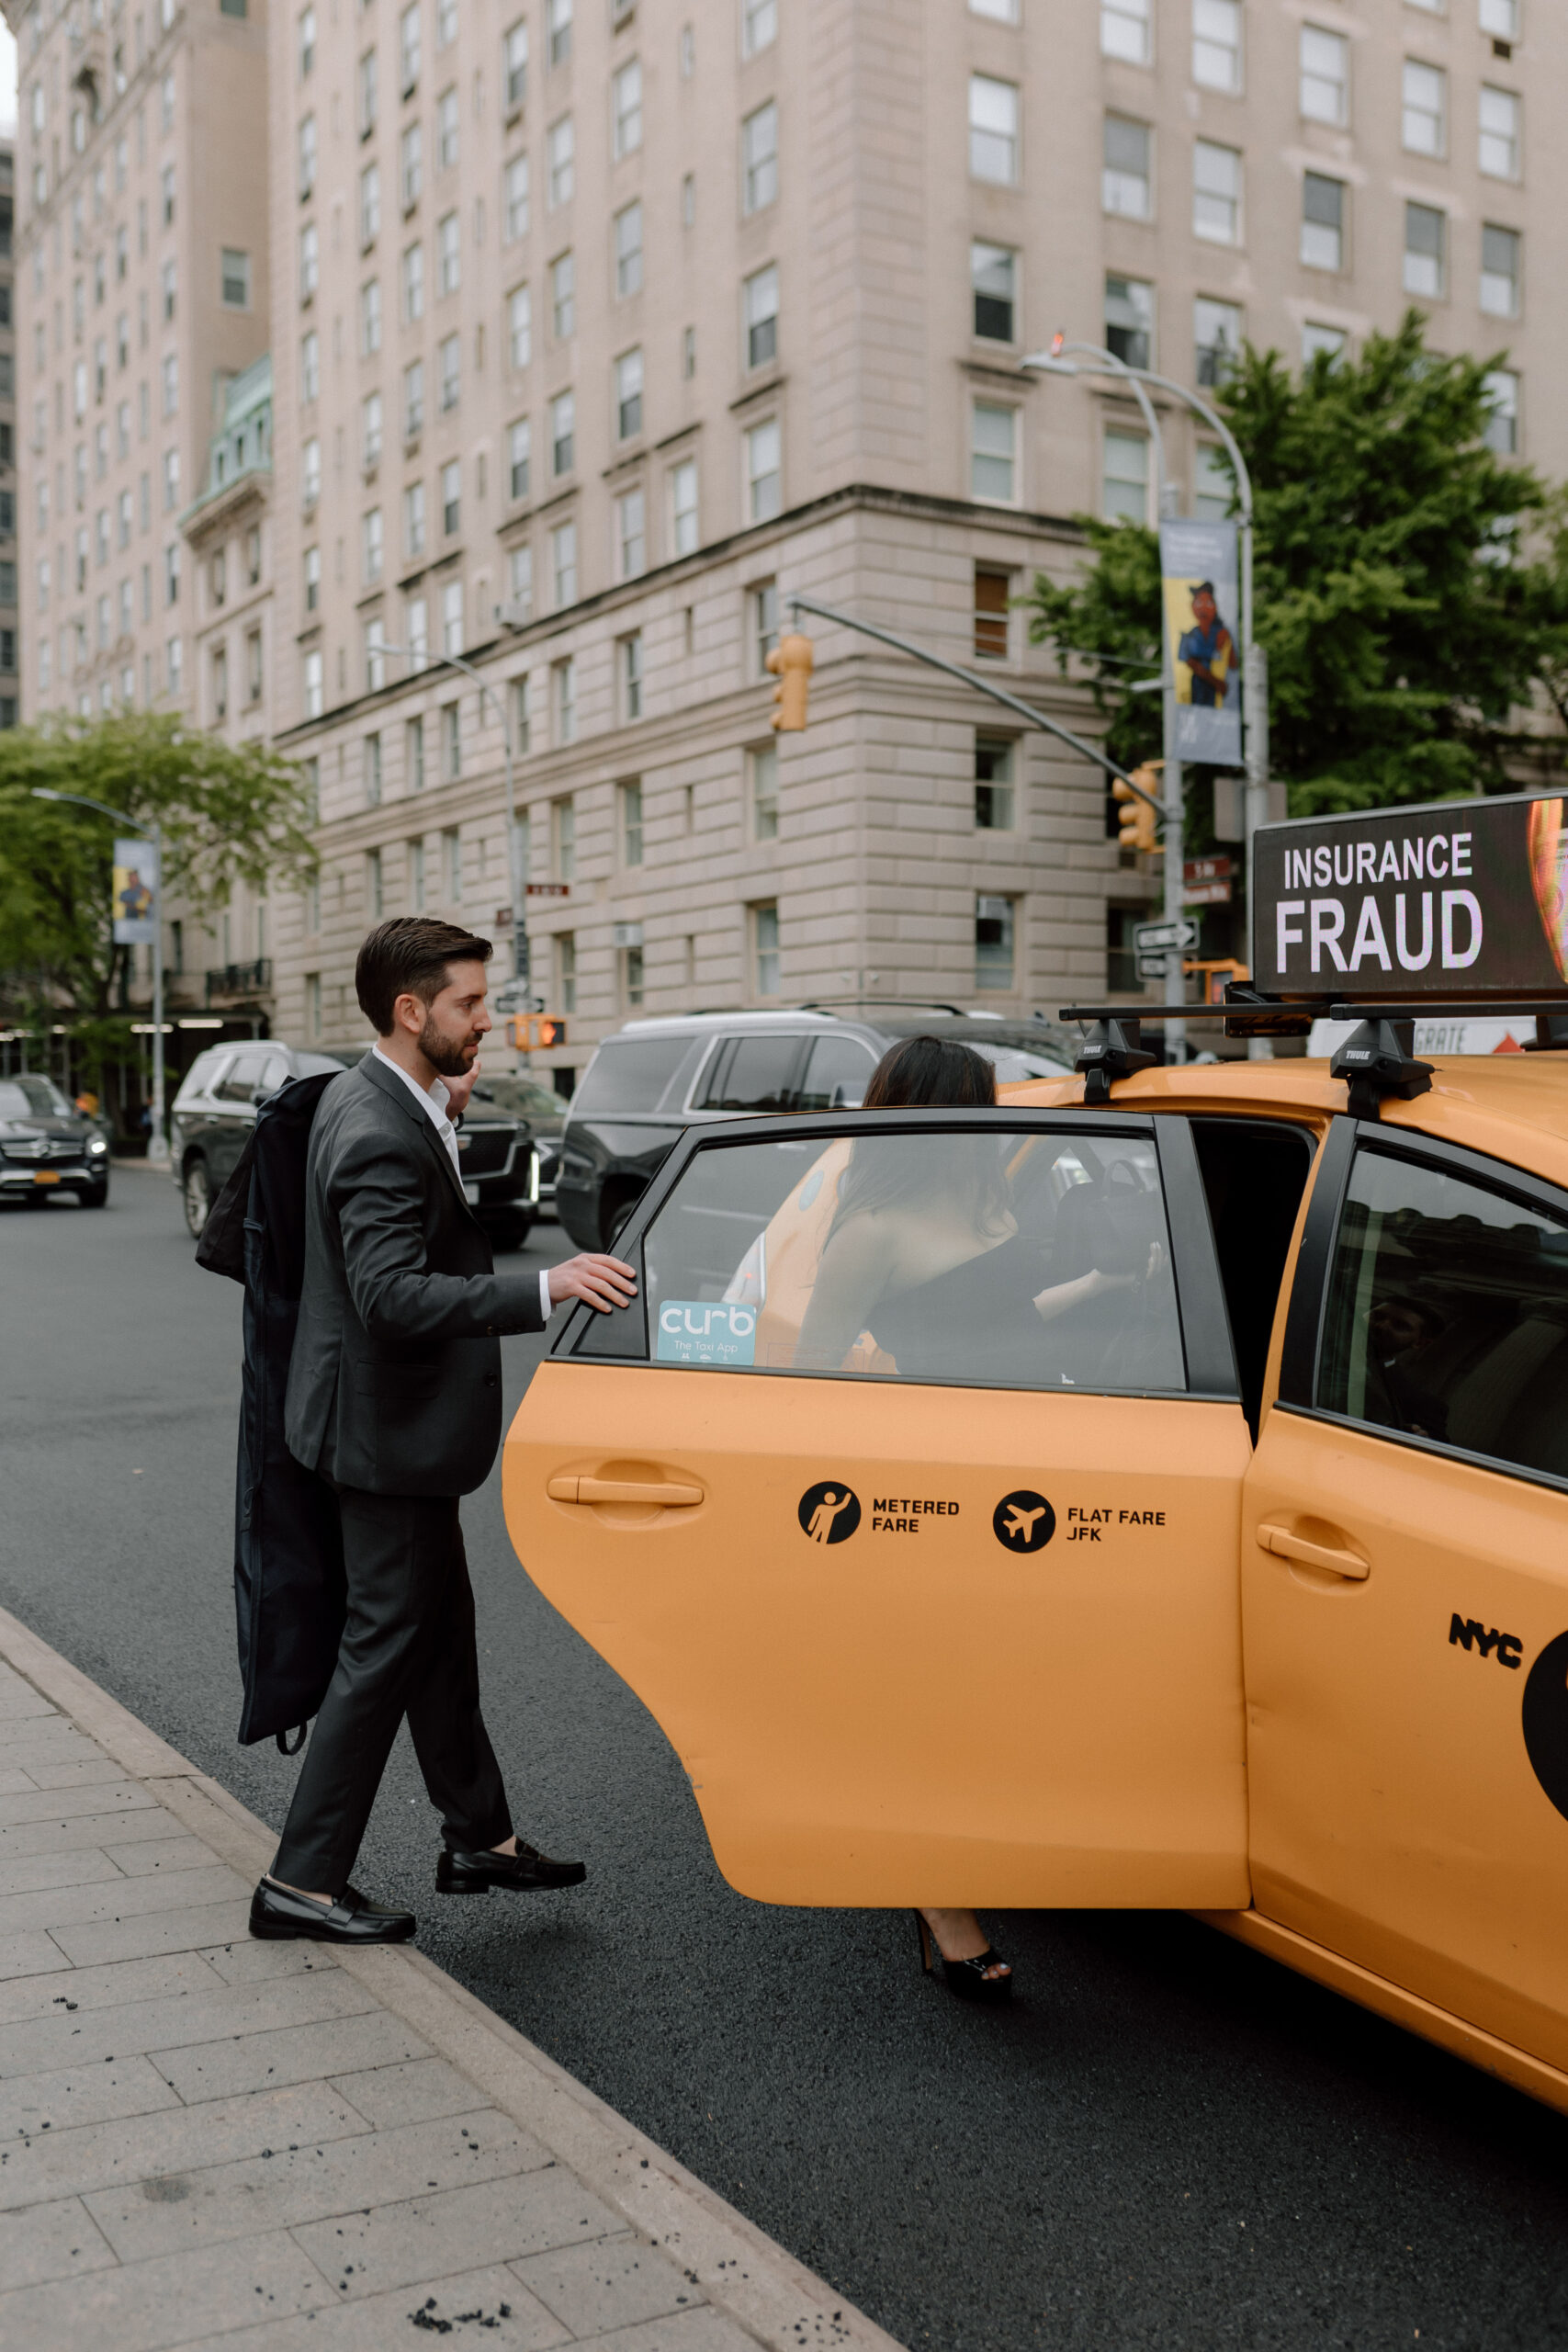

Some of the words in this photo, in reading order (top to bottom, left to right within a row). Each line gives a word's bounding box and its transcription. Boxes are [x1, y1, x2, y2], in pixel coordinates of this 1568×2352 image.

[1284, 832, 1472, 889] INSURANCE
[1276, 888, 1483, 974] FRAUD
[1083, 1045, 1102, 1055] THULE
[1346, 1050, 1371, 1060] THULE
[660, 1306, 755, 1337] curb
[674, 1340, 692, 1351] The
[695, 1341, 715, 1351] Taxi
[716, 1342, 739, 1354] App
[873, 1498, 960, 1516] METERED
[872, 1517, 919, 1532] FARE
[1067, 1508, 1113, 1523] FLAT
[1119, 1510, 1167, 1526] FARE
[1066, 1527, 1102, 1542] JFK
[1449, 1612, 1524, 1670] NYC
